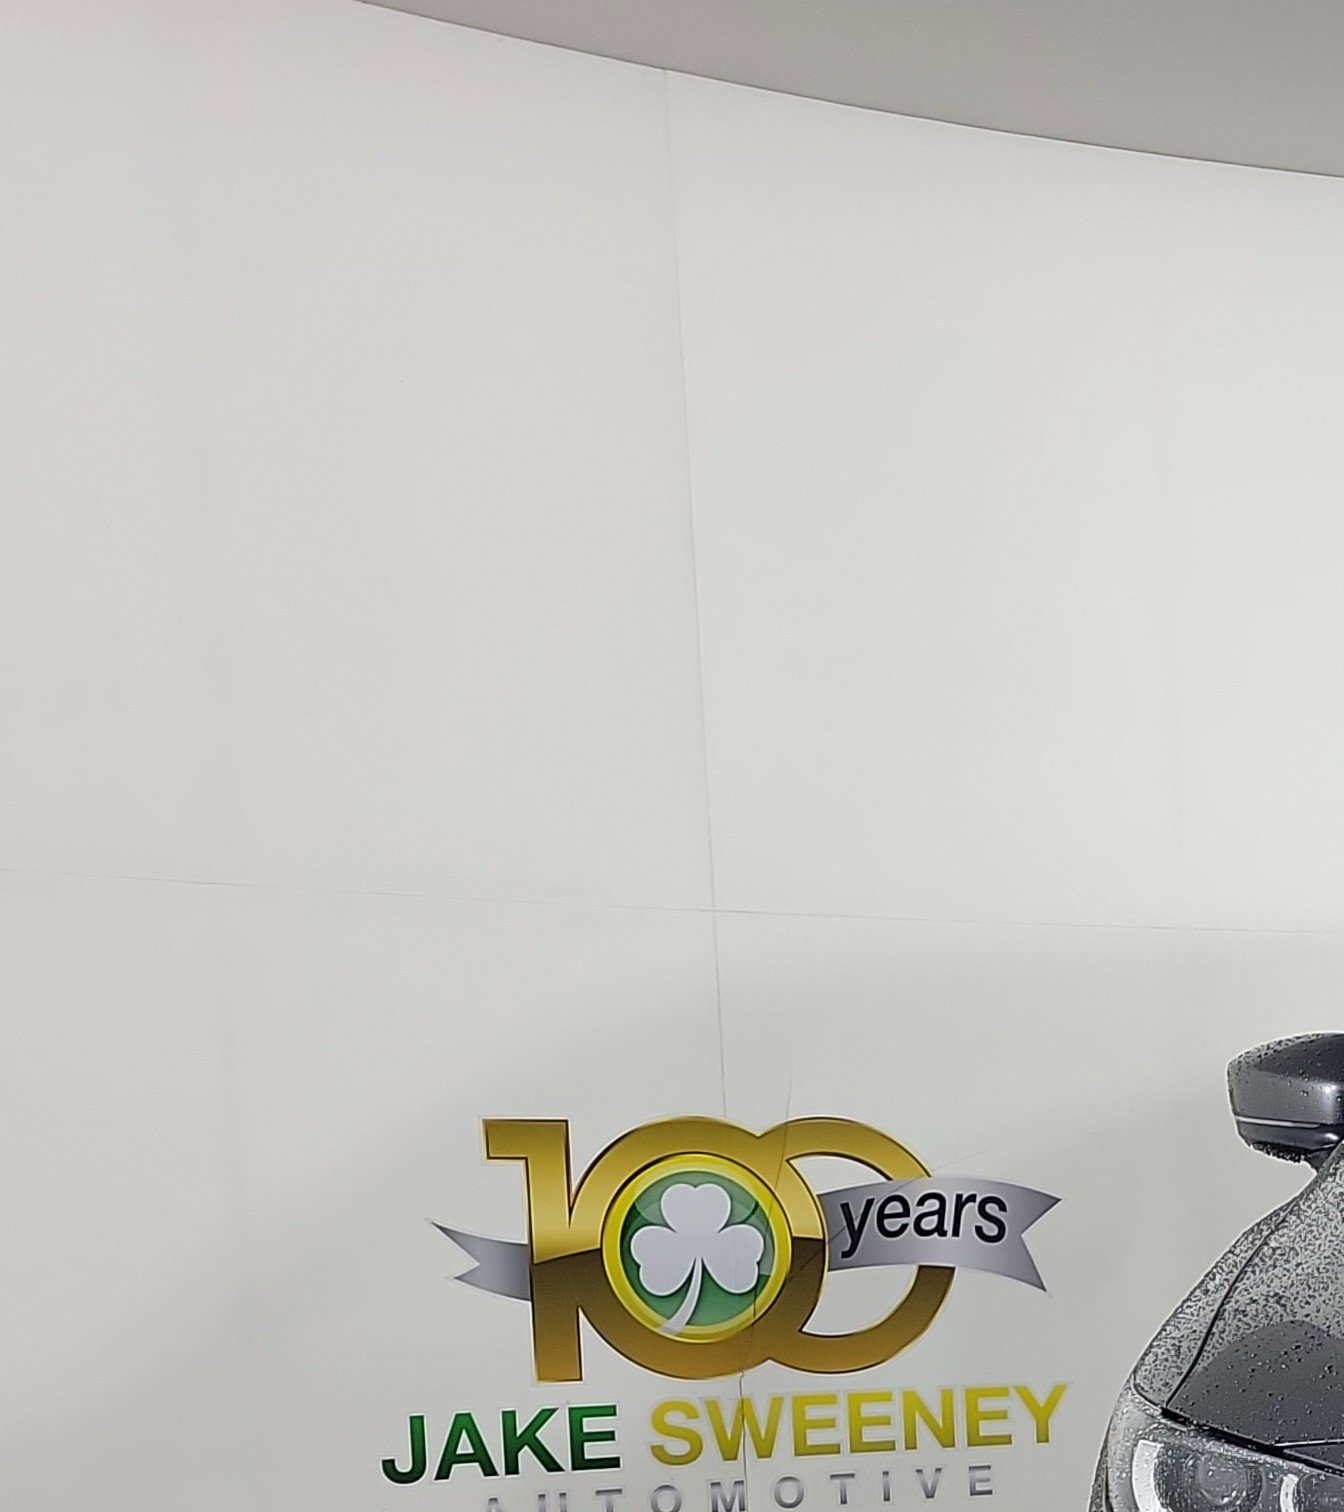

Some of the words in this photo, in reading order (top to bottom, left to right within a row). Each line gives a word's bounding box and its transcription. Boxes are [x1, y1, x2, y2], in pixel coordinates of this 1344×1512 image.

[480, 1115, 957, 1382] 100
[839, 1194, 1009, 1257] years
[382, 1405, 622, 1485] JAKE
[649, 1383, 1068, 1467] SWEENEY
